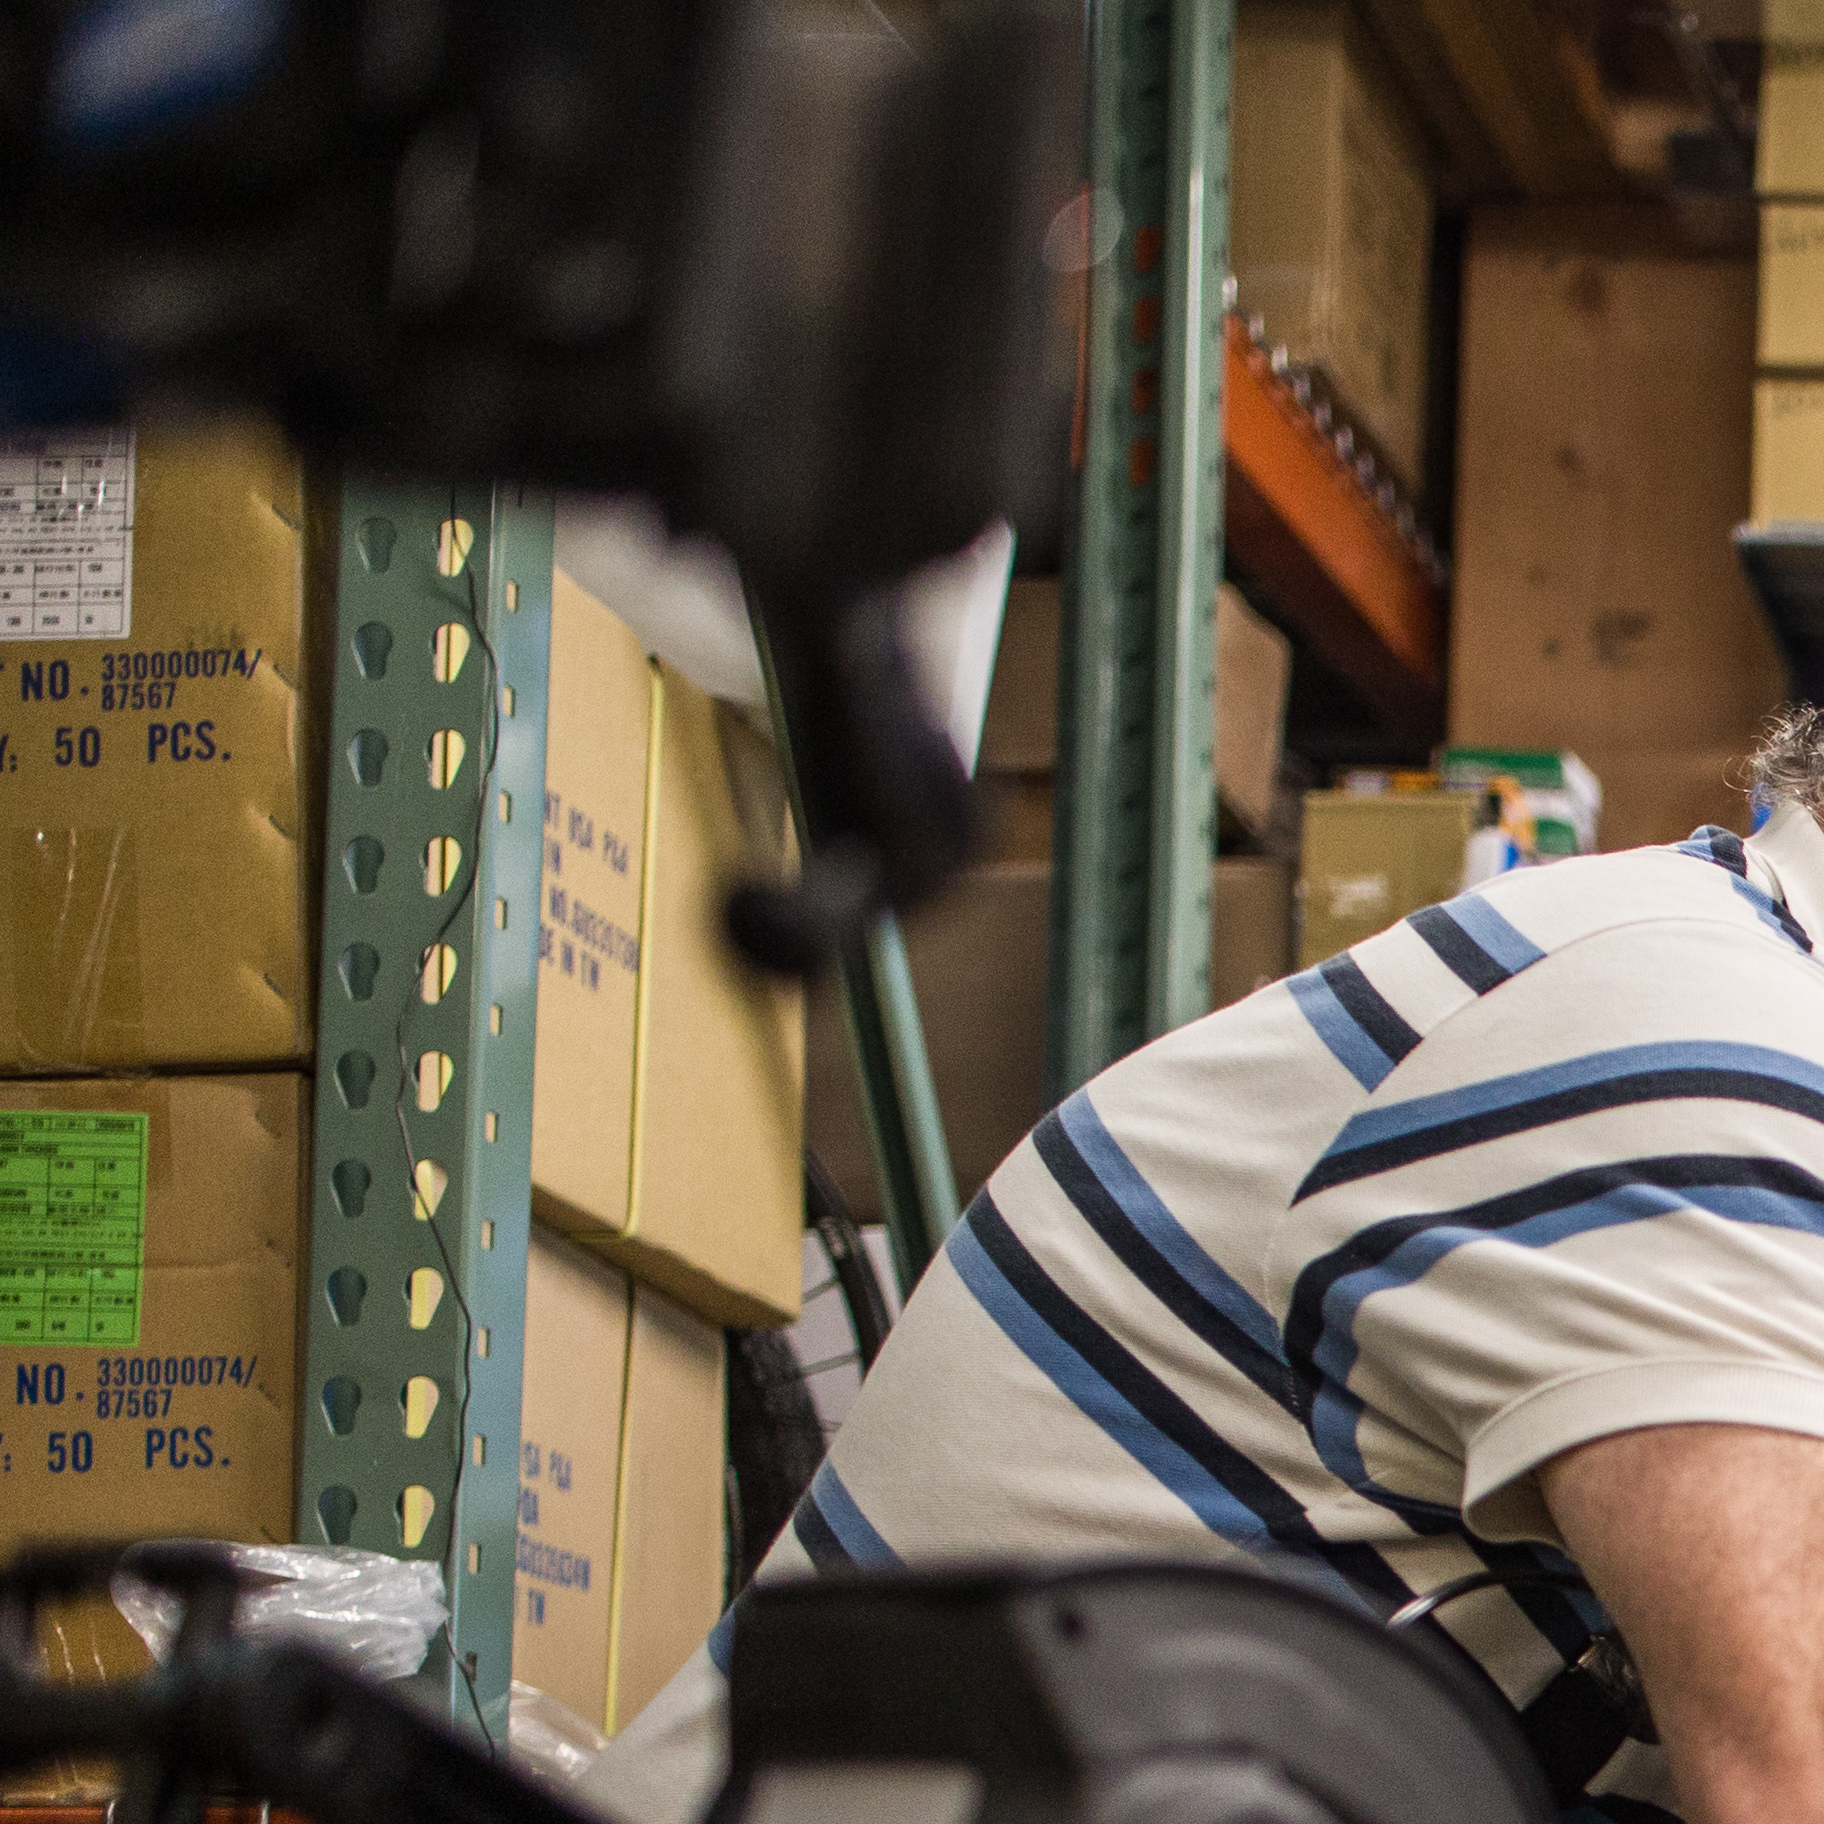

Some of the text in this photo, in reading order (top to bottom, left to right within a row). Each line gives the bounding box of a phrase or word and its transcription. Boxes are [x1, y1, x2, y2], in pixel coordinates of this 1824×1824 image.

[21, 648, 262, 701] NO. 330000074/
[102, 682, 176, 711] 87567
[55, 726, 100, 767] 50
[148, 720, 231, 763] PCS.
[16, 1355, 258, 1405] NO. 330000074/
[97, 1389, 172, 1419] 87567
[48, 1430, 93, 1473] 50
[145, 1425, 230, 1469] PCS.
